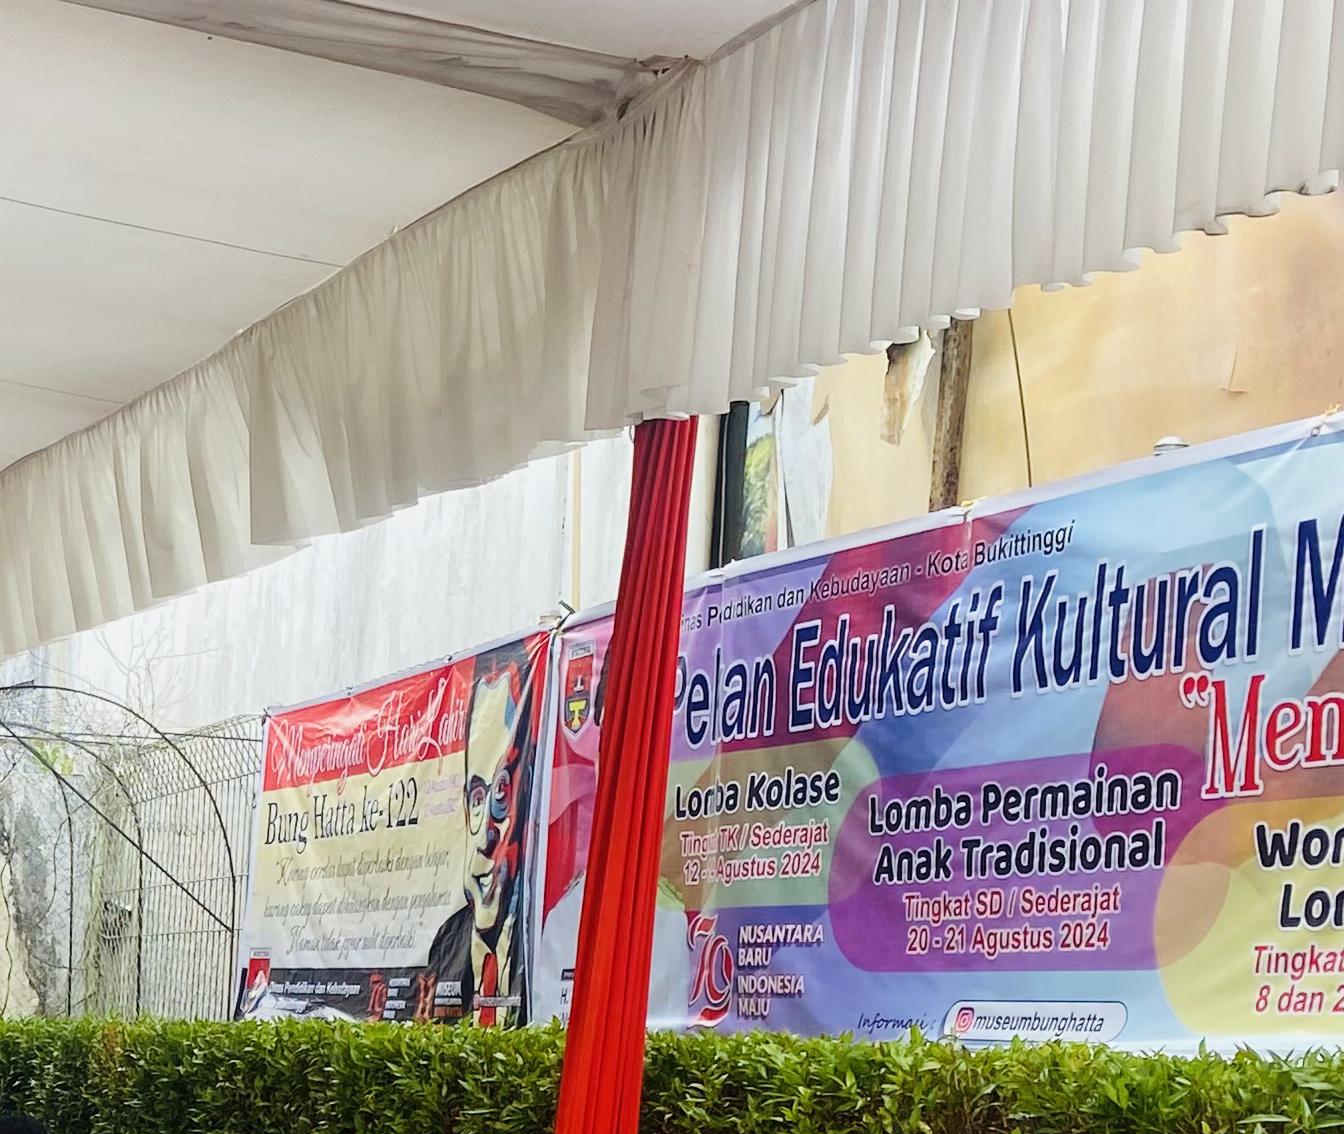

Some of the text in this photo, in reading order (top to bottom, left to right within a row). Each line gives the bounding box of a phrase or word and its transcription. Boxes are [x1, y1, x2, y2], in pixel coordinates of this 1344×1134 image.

[777, 586, 805, 610] dan
[810, 563, 910, 600] Kebudayaan
[927, 551, 969, 578] Kota
[974, 520, 1075, 567] Bukittinggi
[791, 585, 1002, 728] Edukatif
[1014, 529, 1264, 693] Kultural
[747, 769, 840, 808] Kolase
[870, 766, 1179, 833] Lomba Permainan
[265, 803, 309, 854] Bung
[314, 795, 355, 839] Hatta
[359, 778, 418, 833] ke-122
[720, 828, 738, 849] TK
[751, 820, 828, 851] Sederajat
[874, 821, 1164, 883] Anak Tradisional
[684, 861, 700, 884] 12
[717, 856, 776, 886] Agustus
[781, 852, 821, 876] 2024
[904, 886, 1119, 923] Tingkat SD / Sederajat
[738, 924, 824, 945] NUSANTARA
[907, 928, 928, 952] 20
[945, 926, 965, 951] 21
[972, 925, 1053, 956] Agustus
[1061, 922, 1109, 948] 2024
[737, 948, 771, 967] BARU
[737, 975, 805, 996] INDONESIA
[1255, 985, 1272, 1013] 8
[1277, 985, 1325, 1013] dan
[737, 1000, 771, 1018] MAJU
[973, 1010, 1105, 1036] museumbunghatta
